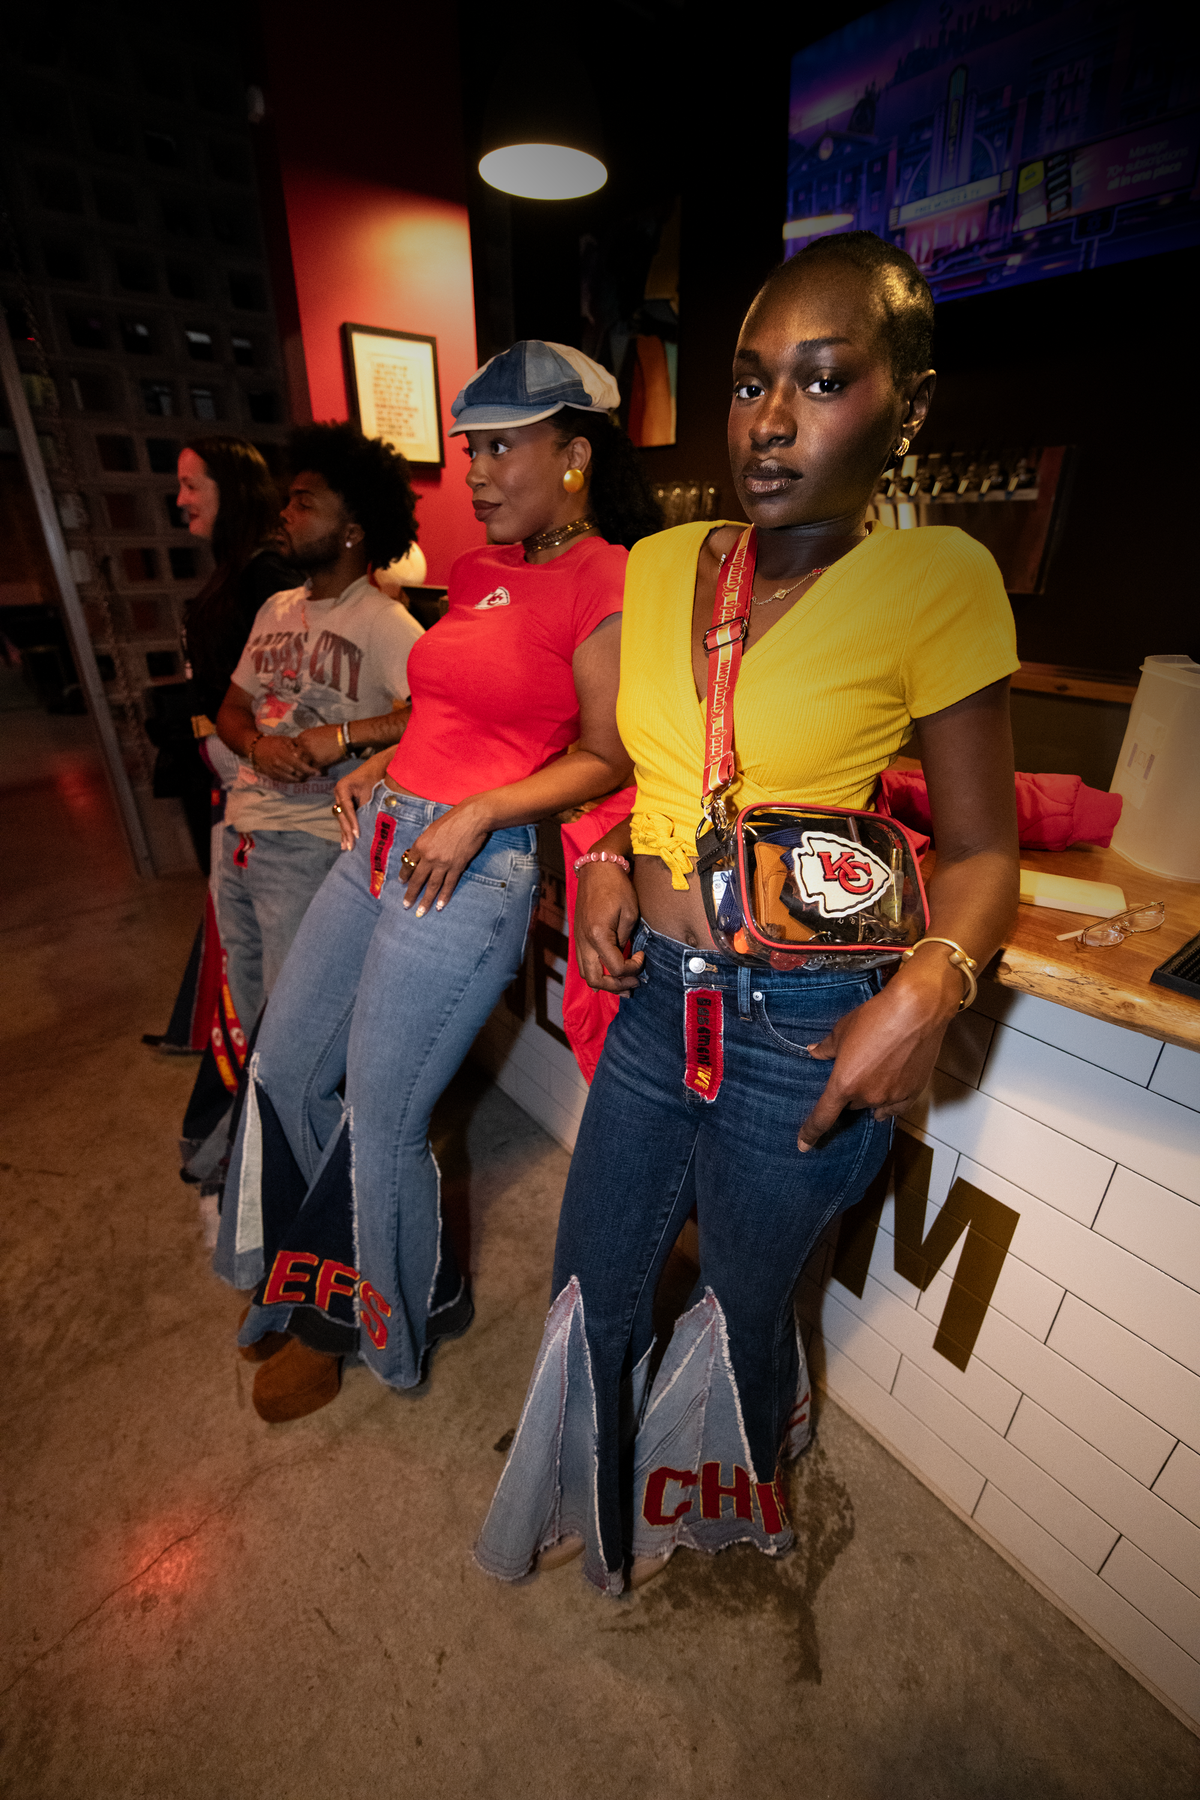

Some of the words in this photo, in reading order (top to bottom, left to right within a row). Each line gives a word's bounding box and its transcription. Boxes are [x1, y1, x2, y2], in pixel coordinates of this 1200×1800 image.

[1129, 140, 1169, 159] Manage
[1152, 161, 1182, 180] place
[309, 630, 363, 702] CITY
[711, 660, 731, 724] Kingdom
[817, 851, 875, 894] KC
[696, 997, 712, 1067] Basement
